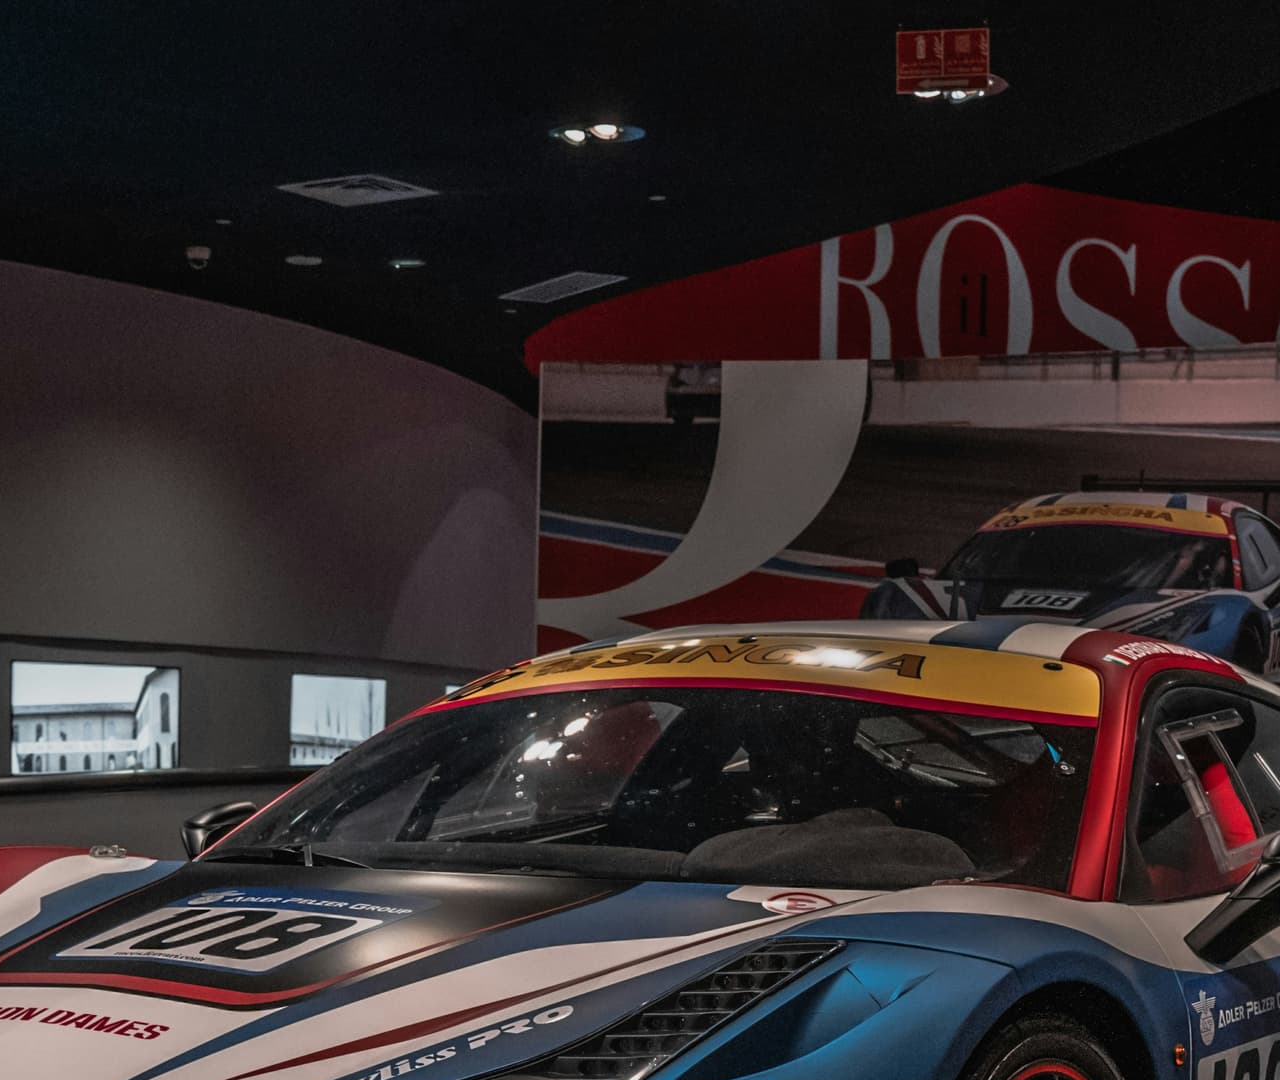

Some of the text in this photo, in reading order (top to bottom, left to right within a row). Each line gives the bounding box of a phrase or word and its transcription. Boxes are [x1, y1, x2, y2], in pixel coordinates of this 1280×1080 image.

[959, 273, 989, 336] il
[1014, 593, 1075, 607] 108
[592, 643, 925, 679] SINGA
[223, 894, 413, 915] ADLER PELZER GROUP
[84, 909, 358, 960] 108
[39, 1009, 170, 1040] DAMES
[467, 1004, 574, 1050] PRO
[1217, 1005, 1245, 1029] ADLER
[1245, 996, 1277, 1020] PELZER
